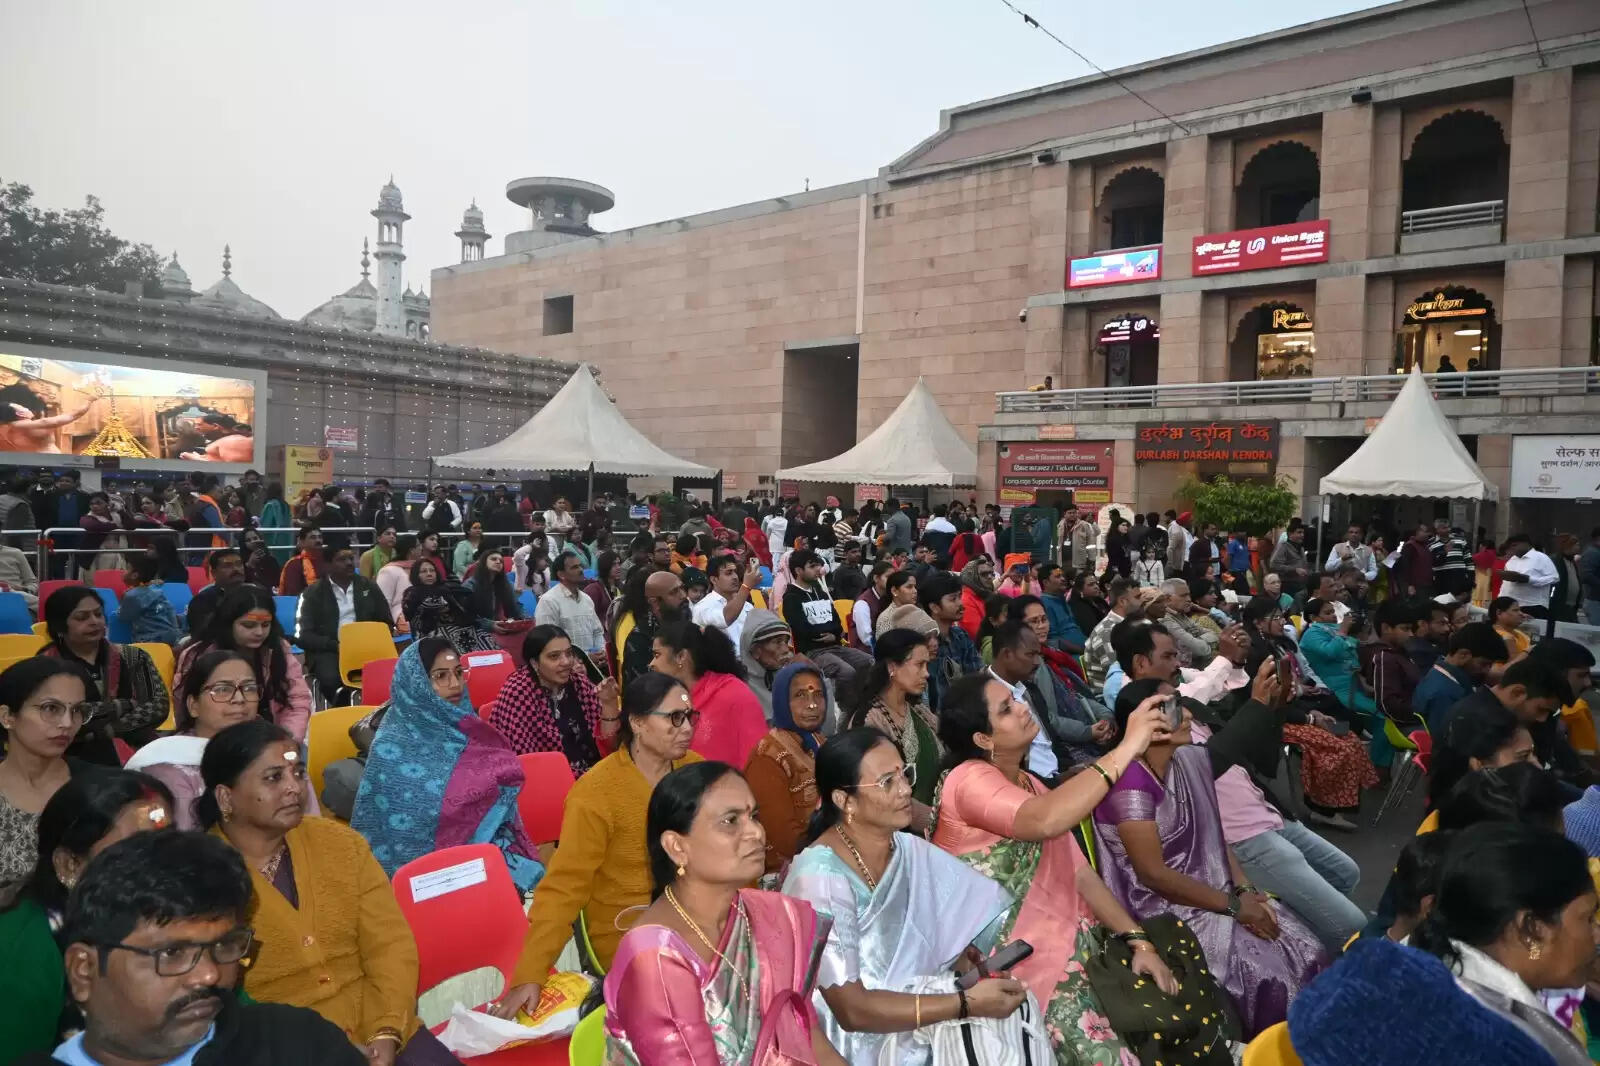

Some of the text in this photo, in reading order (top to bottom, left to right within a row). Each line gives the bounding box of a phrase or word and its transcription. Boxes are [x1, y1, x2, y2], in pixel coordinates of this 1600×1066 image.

[1271, 234, 1298, 244] Union
[1190, 422, 1235, 447] दर्शन
[1136, 450, 1273, 460] DURLABH DARSHAN KENDRA
[1556, 445, 1586, 458] सेल्फ
[1032, 477, 1053, 486] Support
[1060, 477, 1081, 486] Enquiry
[1082, 477, 1105, 485] Counter
